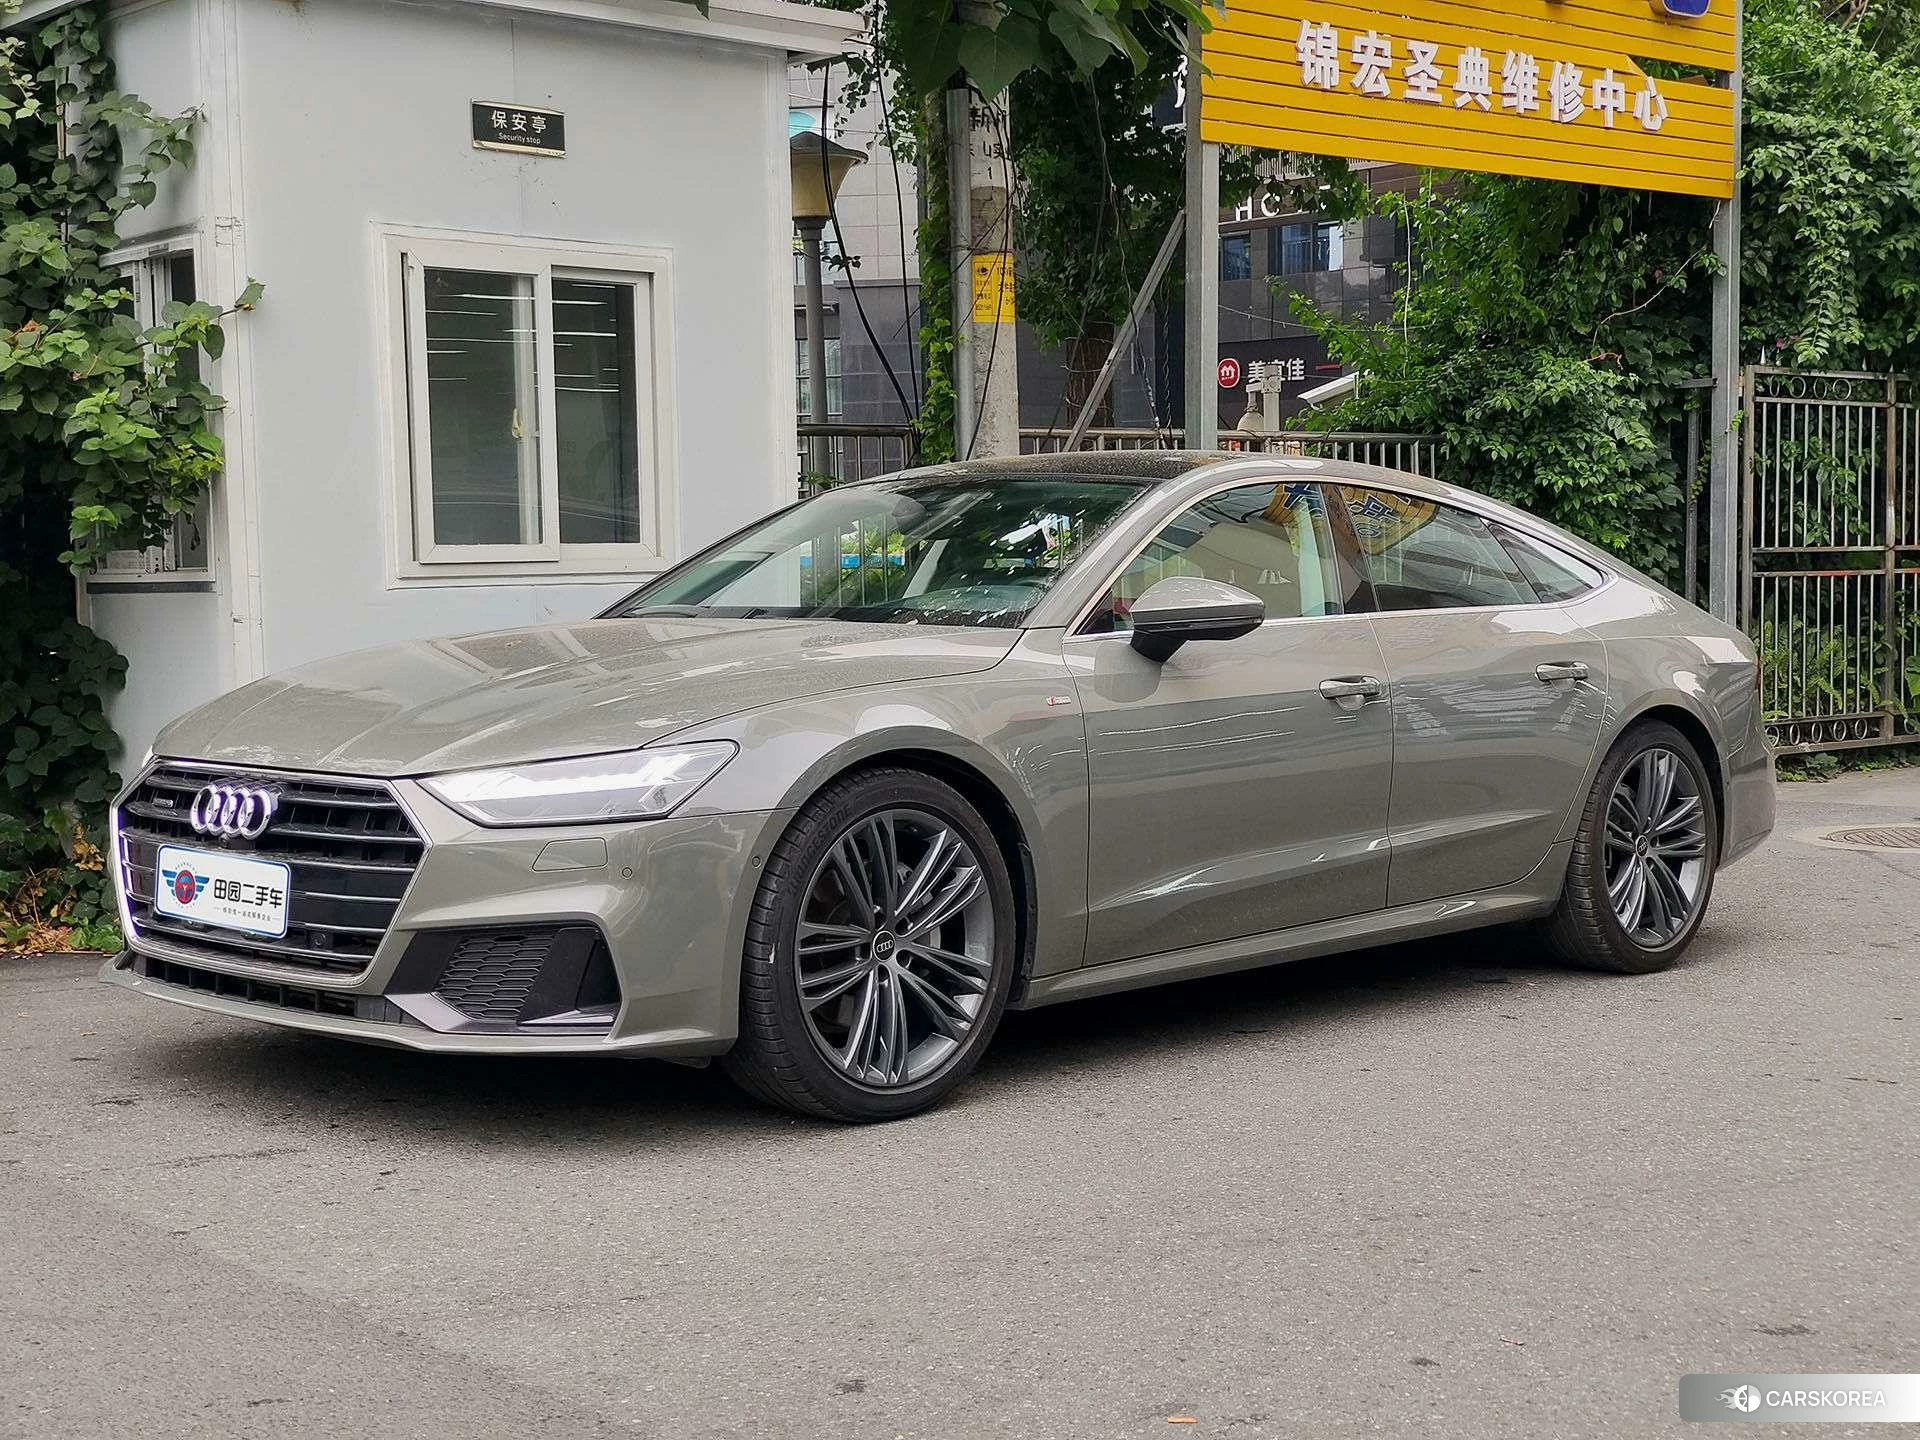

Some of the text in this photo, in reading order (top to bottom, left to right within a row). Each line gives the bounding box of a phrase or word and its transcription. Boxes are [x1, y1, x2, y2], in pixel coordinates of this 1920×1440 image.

[1295, 19, 1669, 131] 锦宏圣典维修中心
[491, 110, 546, 133] 保安亭
[498, 132, 541, 145] Security stop
[214, 878, 284, 908] 田园二手车
